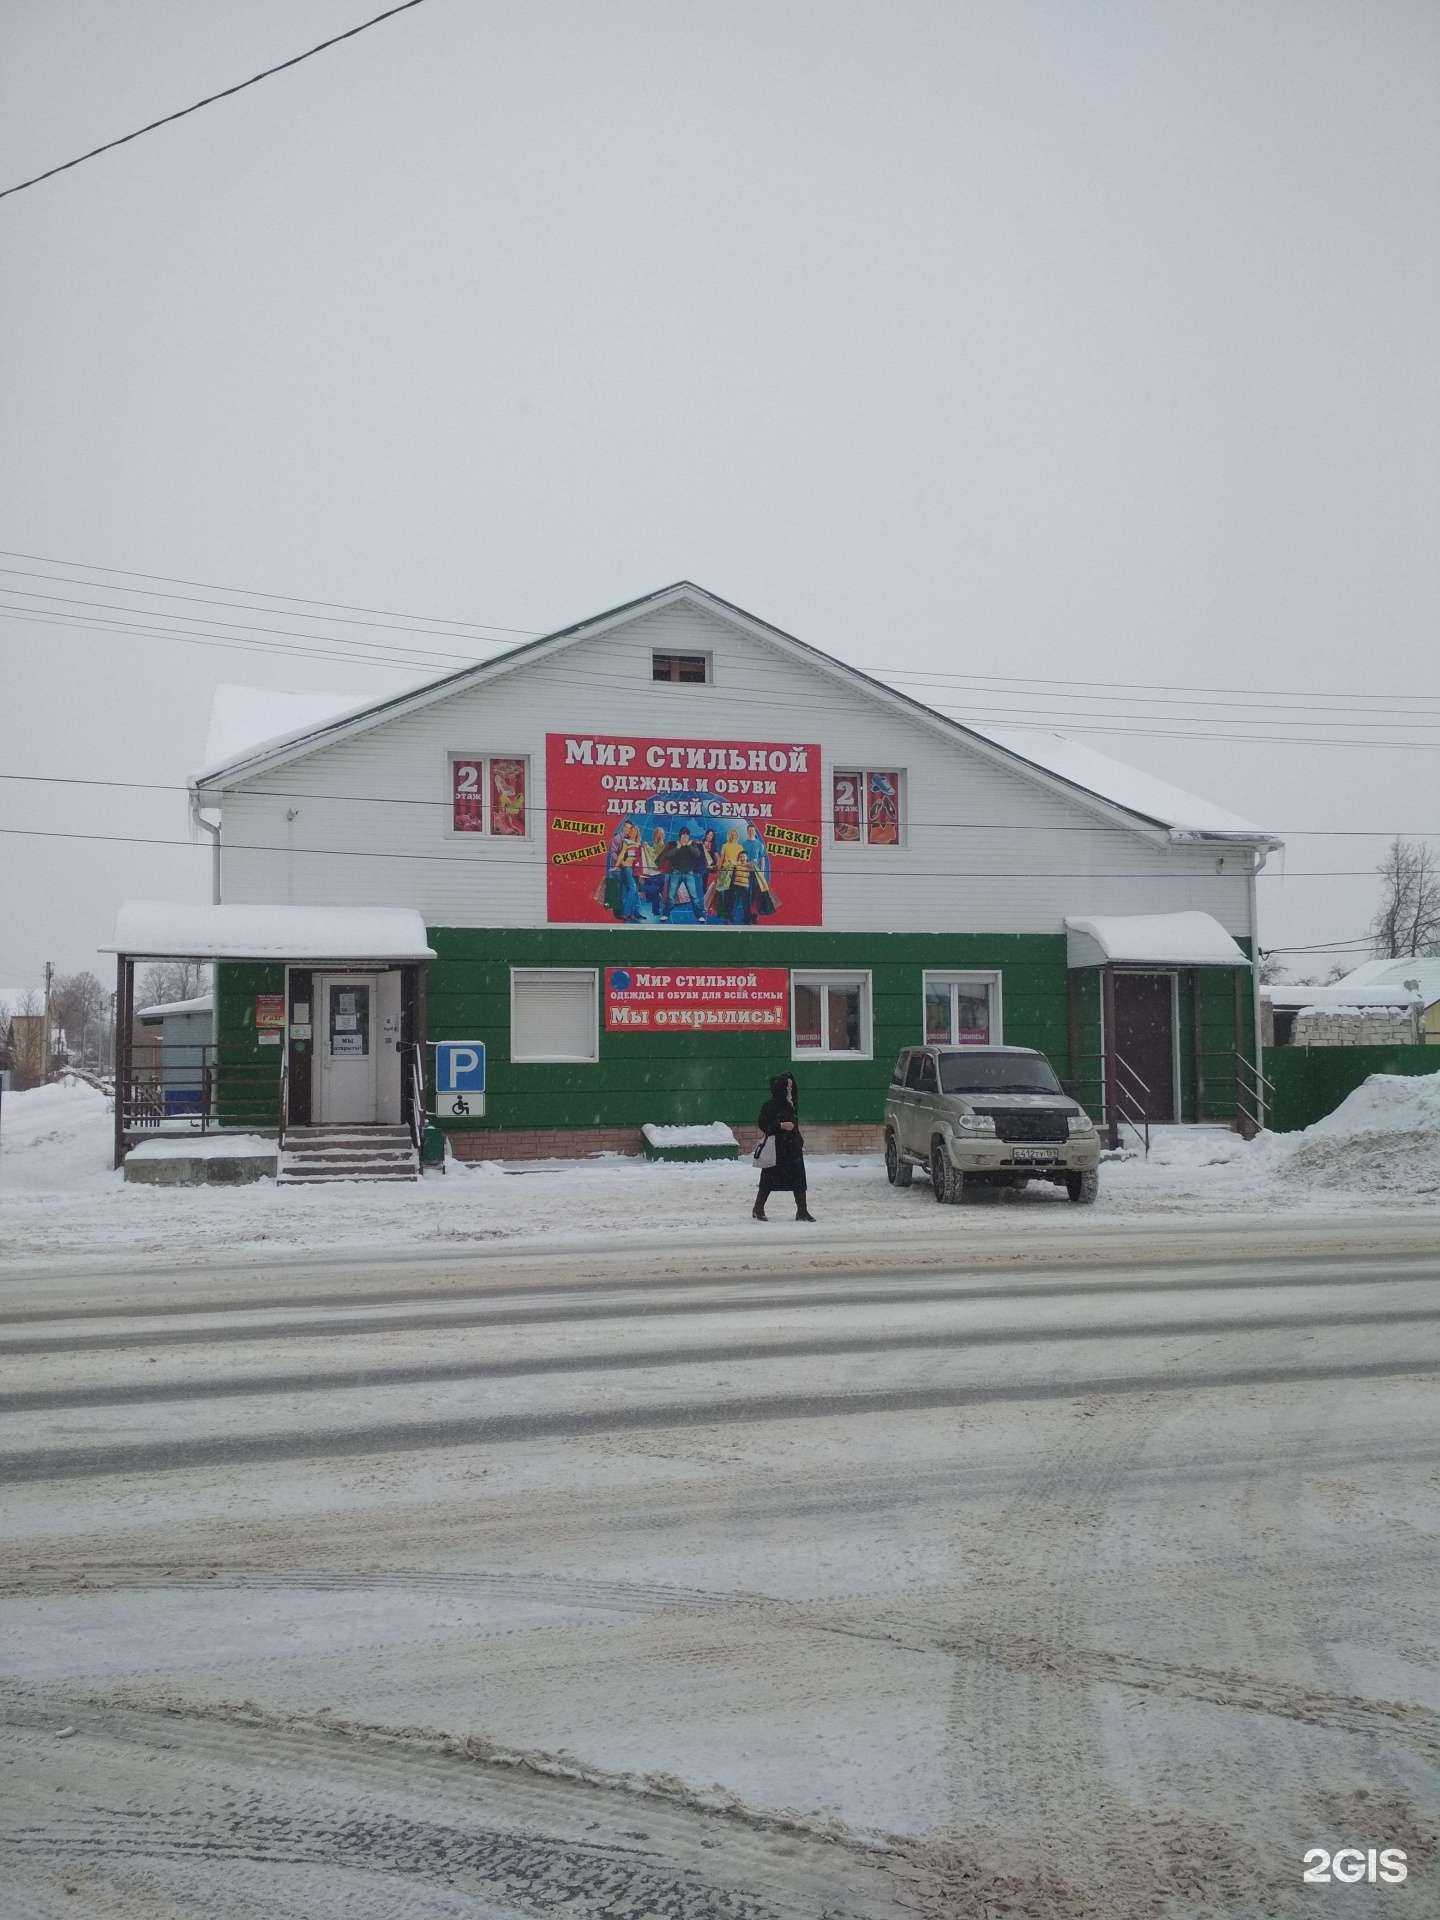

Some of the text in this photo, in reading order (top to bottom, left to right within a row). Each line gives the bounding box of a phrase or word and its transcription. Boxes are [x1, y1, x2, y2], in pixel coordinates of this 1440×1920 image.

[458, 766, 479, 793] 2
[836, 781, 854, 805] 2
[450, 1049, 478, 1088] P
